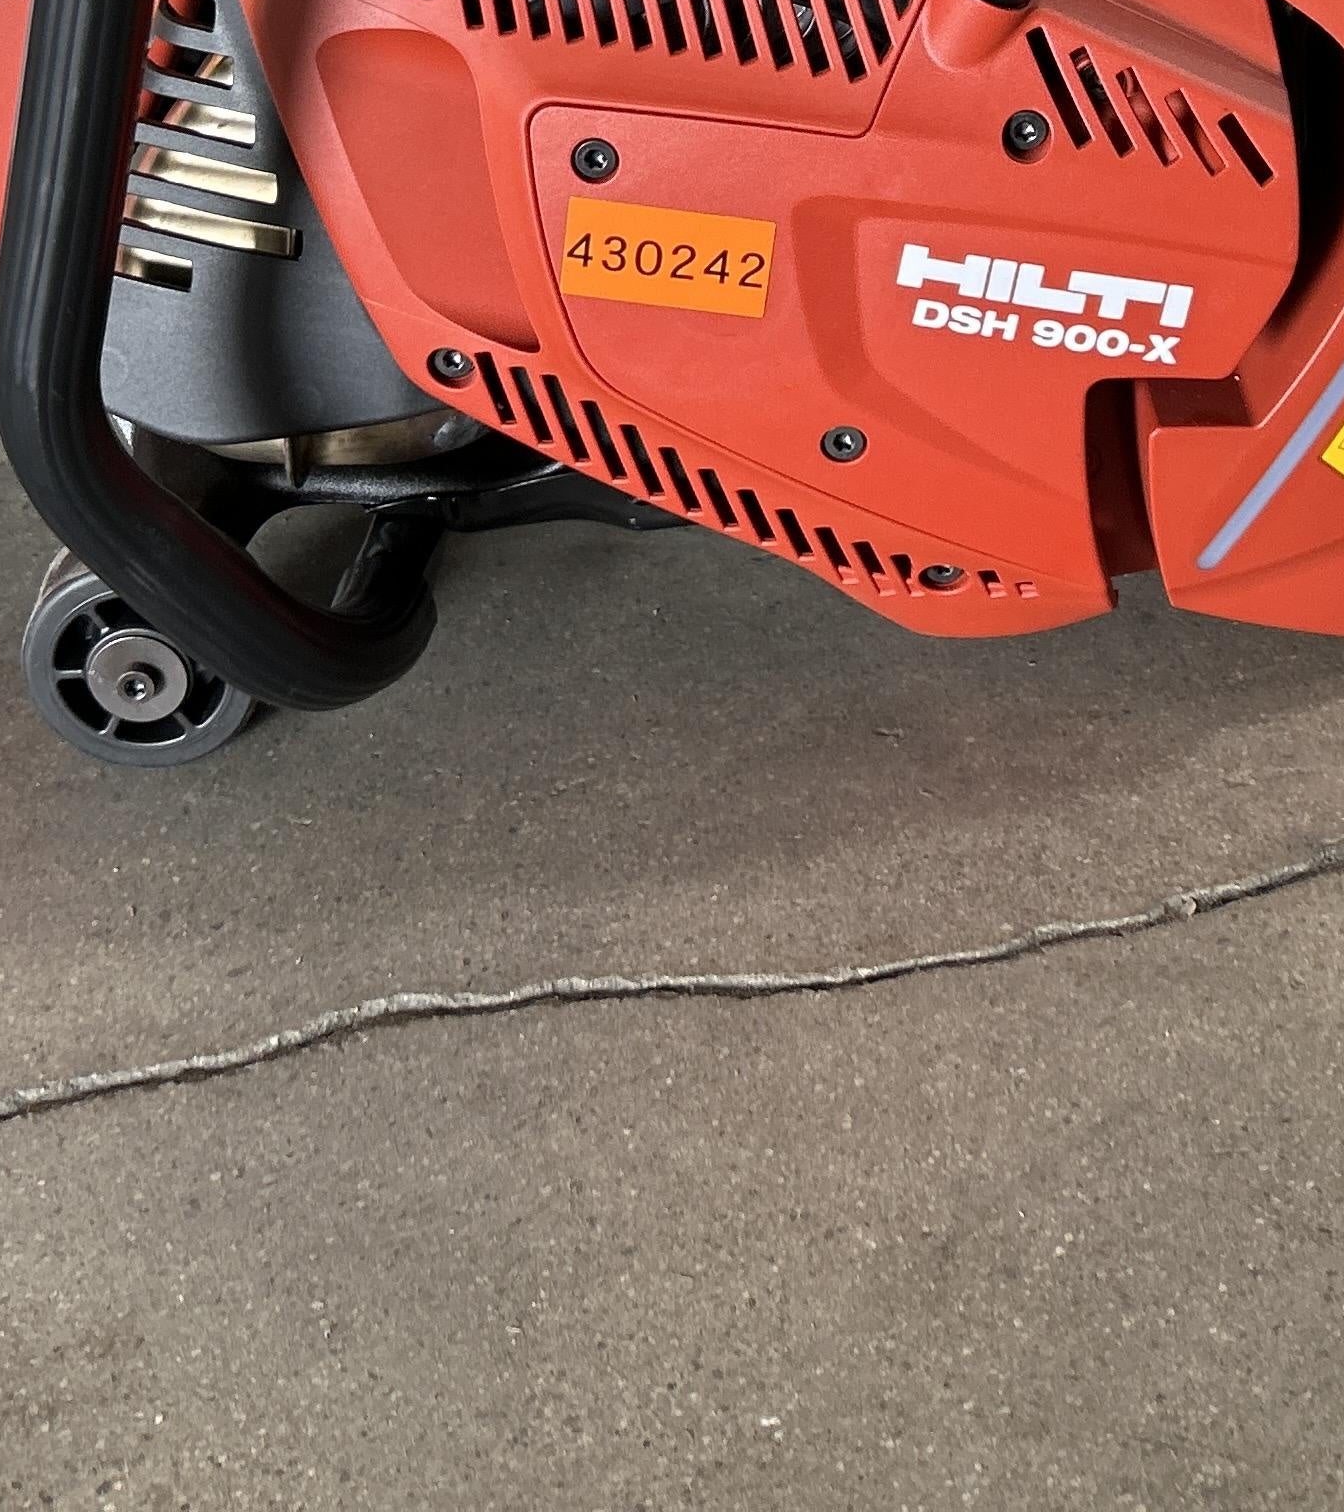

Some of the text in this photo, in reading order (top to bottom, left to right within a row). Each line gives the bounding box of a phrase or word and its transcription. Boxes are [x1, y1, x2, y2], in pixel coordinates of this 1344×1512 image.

[566, 233, 765, 288] 430242
[896, 243, 1194, 329] HILTI
[912, 298, 1181, 365] DSH 900-X
